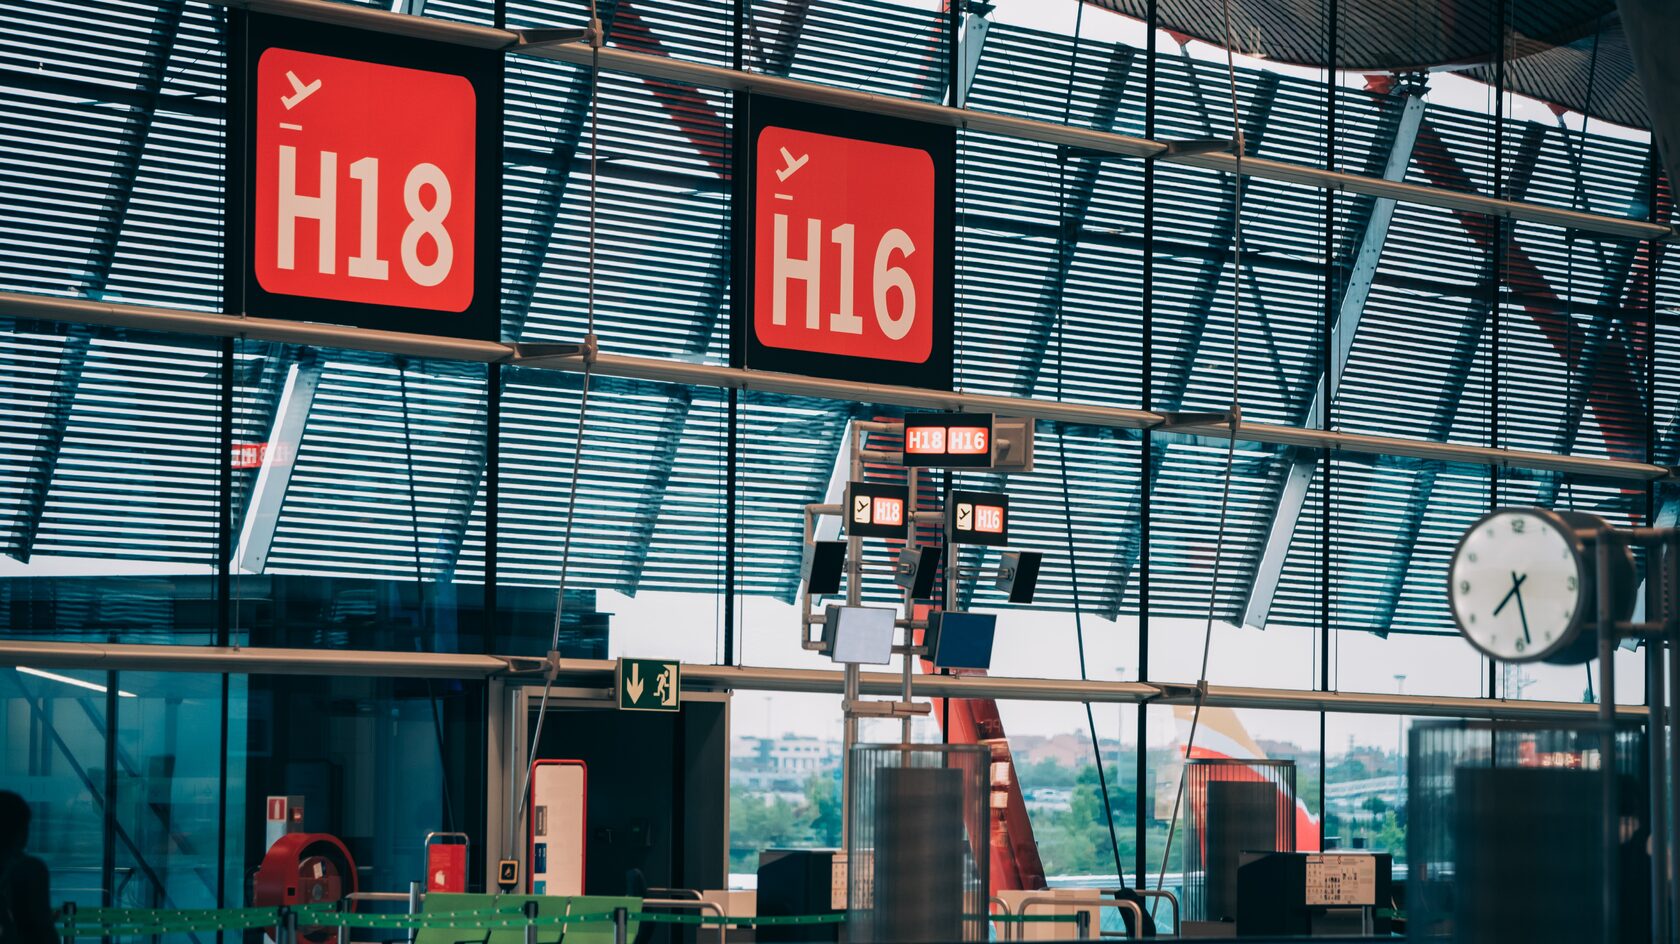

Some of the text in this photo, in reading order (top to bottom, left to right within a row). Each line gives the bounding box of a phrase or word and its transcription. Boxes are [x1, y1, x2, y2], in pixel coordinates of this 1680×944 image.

[277, 144, 454, 287] H18
[772, 213, 916, 341] H16
[909, 431, 985, 450] H18 H16
[876, 501, 900, 522] H18
[978, 510, 1000, 529] H16
[1461, 580, 1470, 596] 9
[1567, 576, 1576, 592] 3
